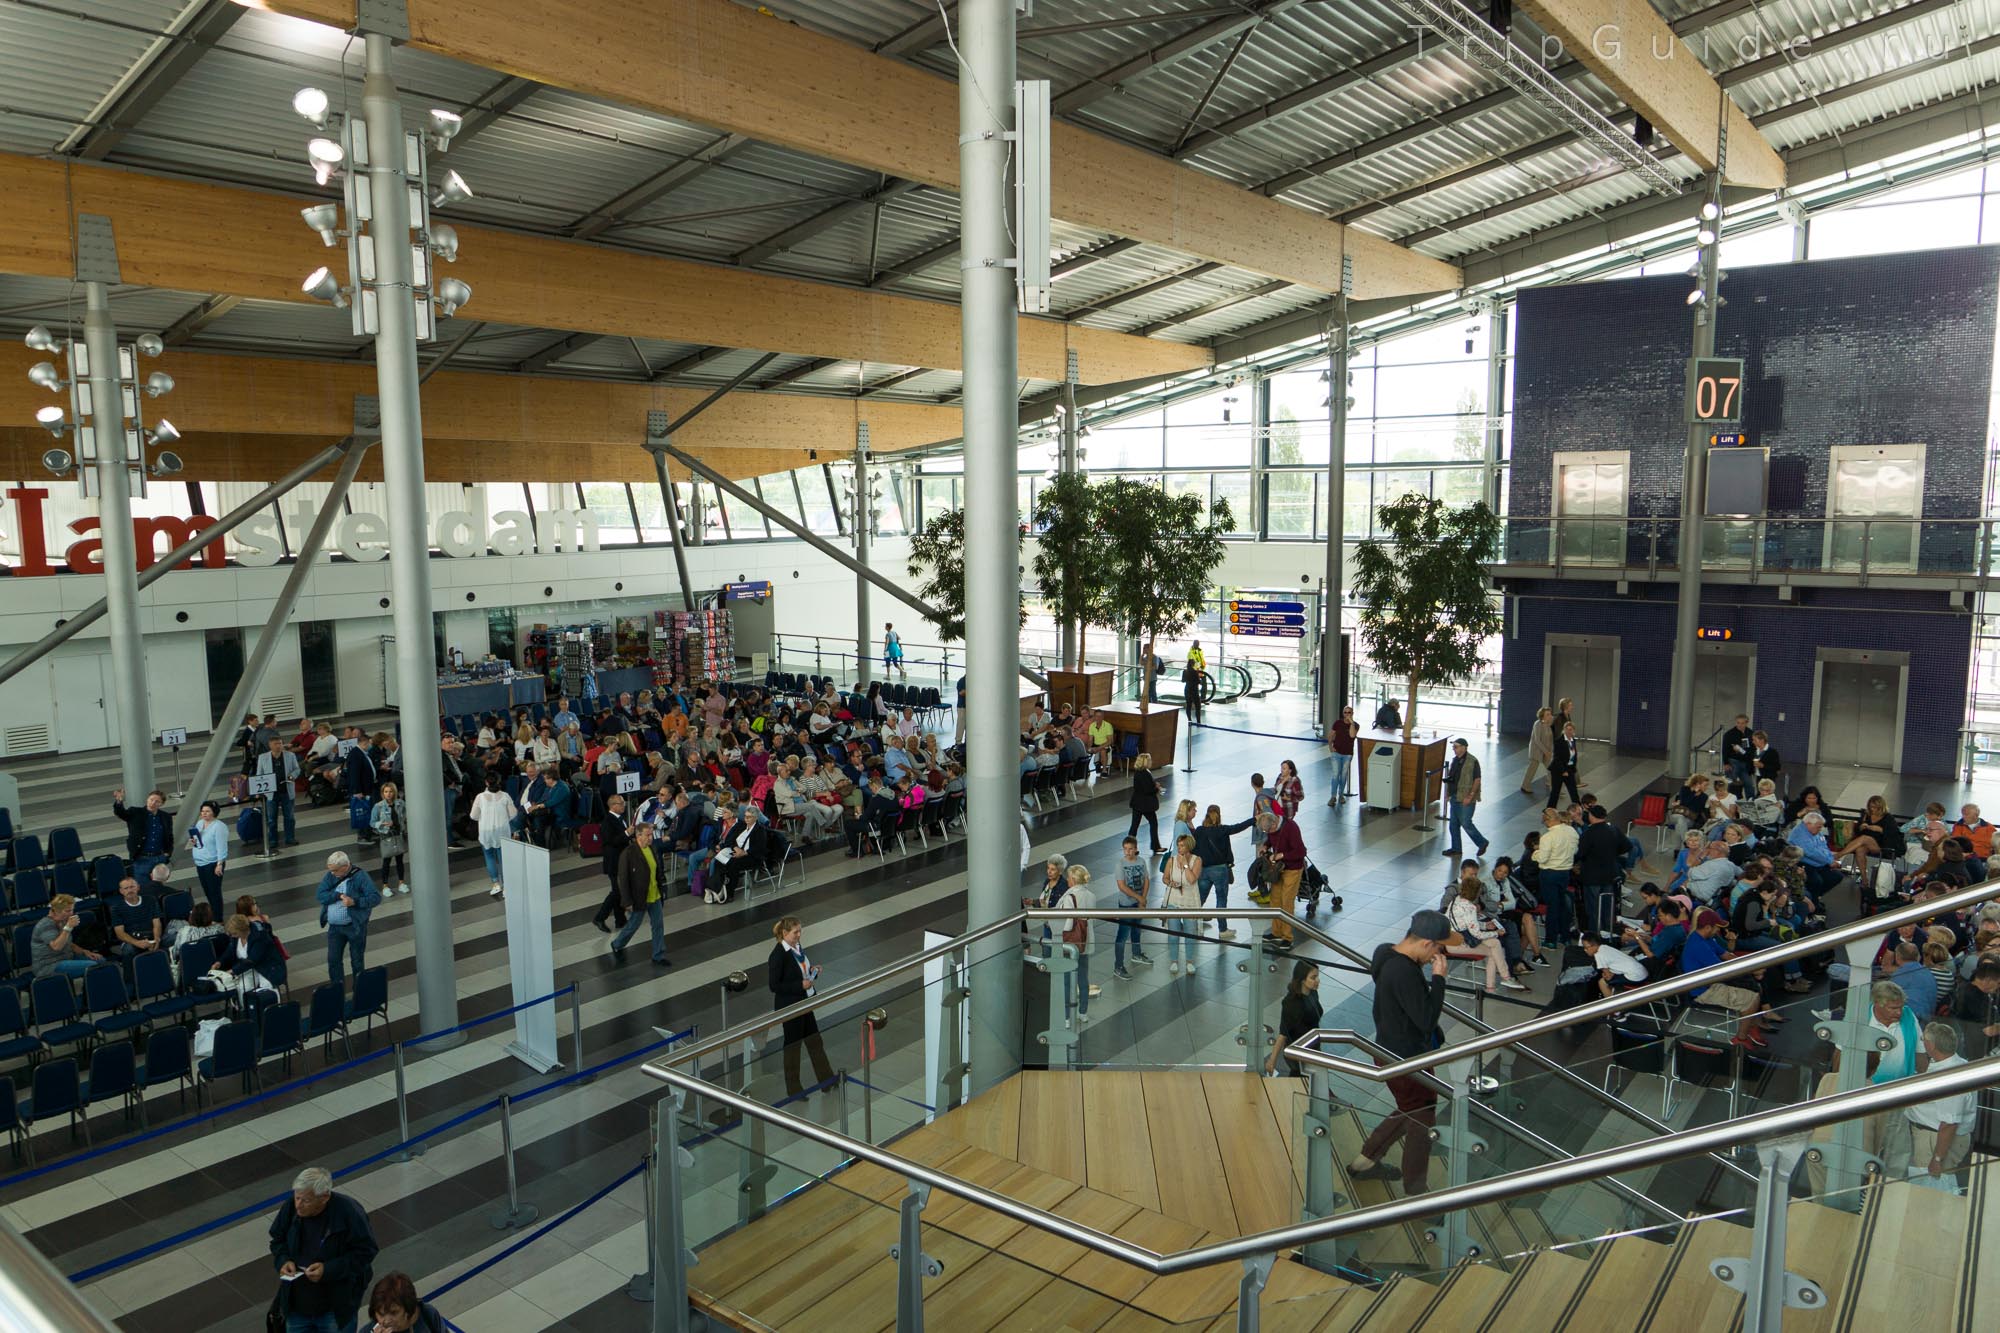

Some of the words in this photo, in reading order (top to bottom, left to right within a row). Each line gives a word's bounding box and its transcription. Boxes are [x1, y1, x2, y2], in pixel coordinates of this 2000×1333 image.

[1696, 376, 1740, 418] 07
[1707, 629, 1721, 637] Lift
[168, 735, 179, 745] 21
[256, 782, 270, 793] 22
[623, 781, 634, 791] 19
